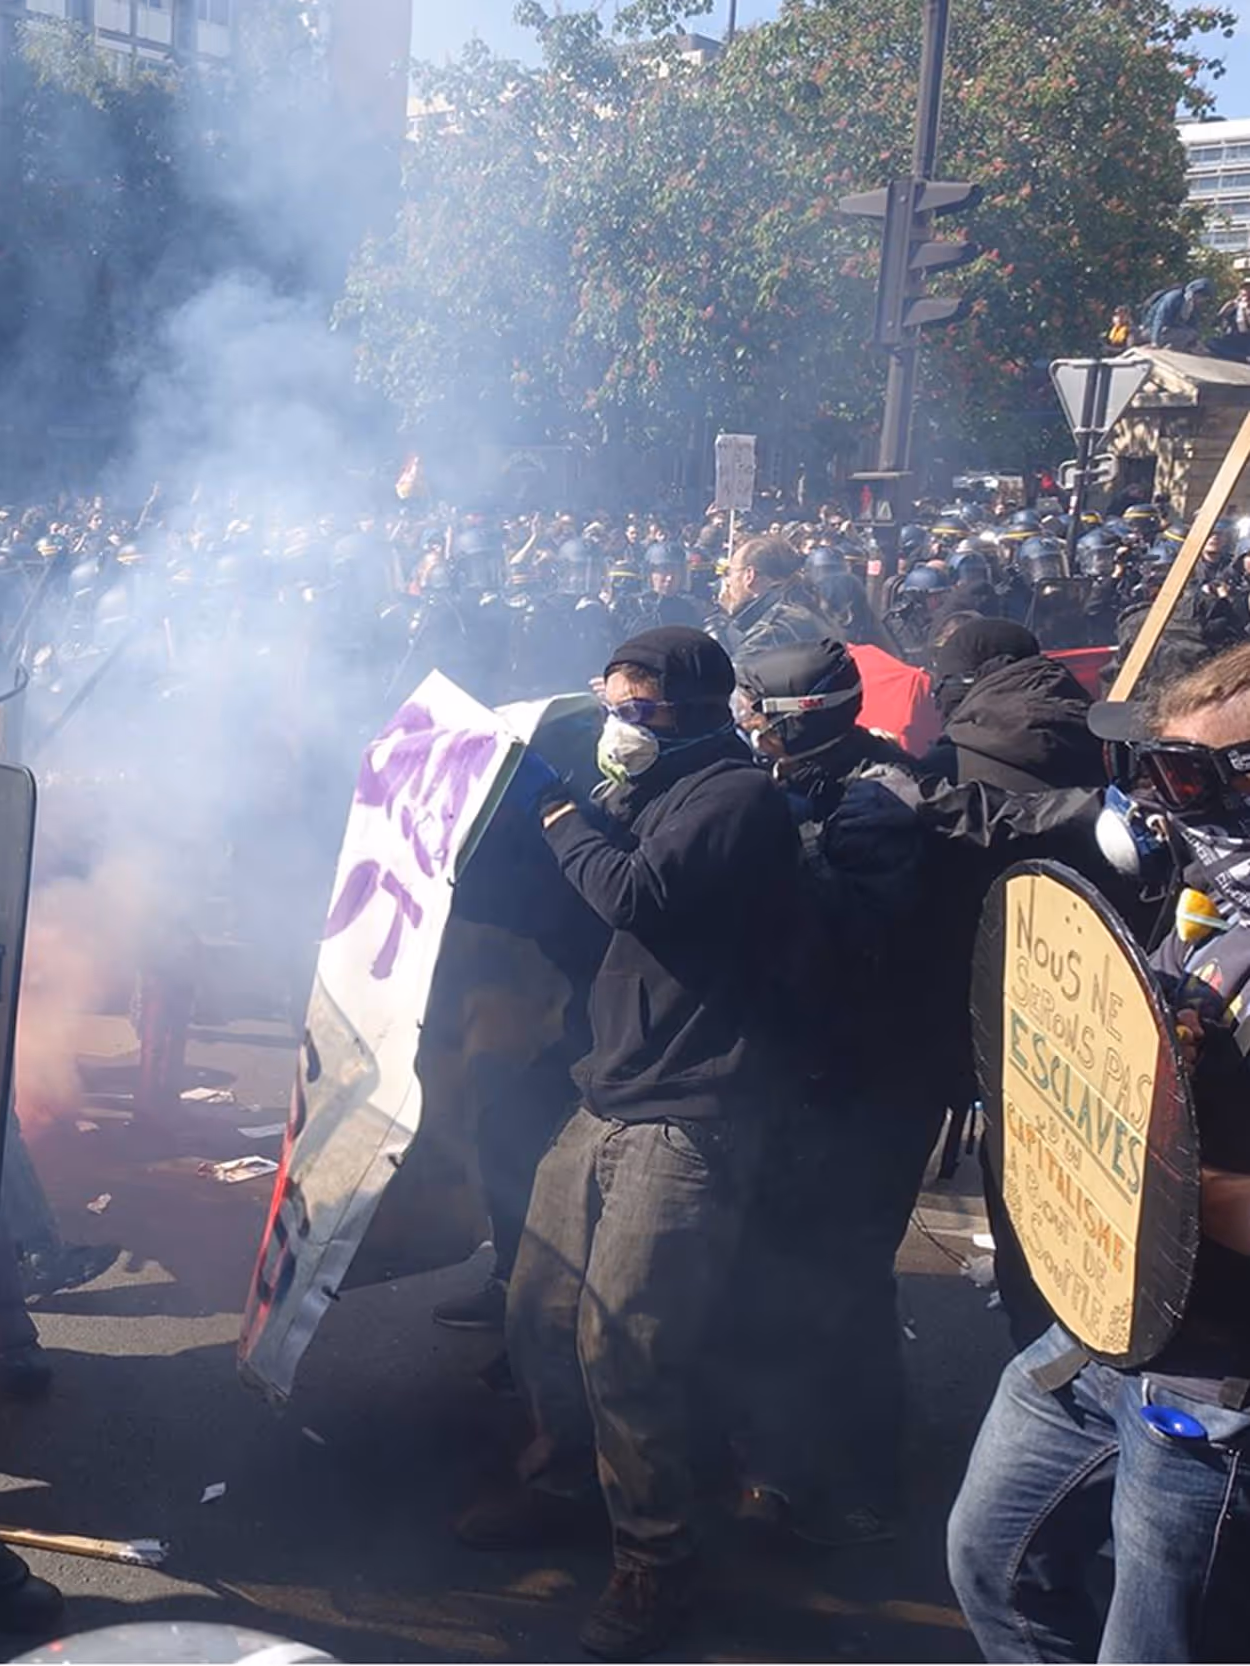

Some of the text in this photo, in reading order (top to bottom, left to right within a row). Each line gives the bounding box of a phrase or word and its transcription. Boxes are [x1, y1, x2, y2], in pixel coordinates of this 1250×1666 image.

[1091, 953, 1124, 1043] NE
[1010, 1008, 1143, 1195] ESCLAVES
[1100, 1046, 1153, 1133] PAS
[1006, 1102, 1125, 1274] CAPITALISME
